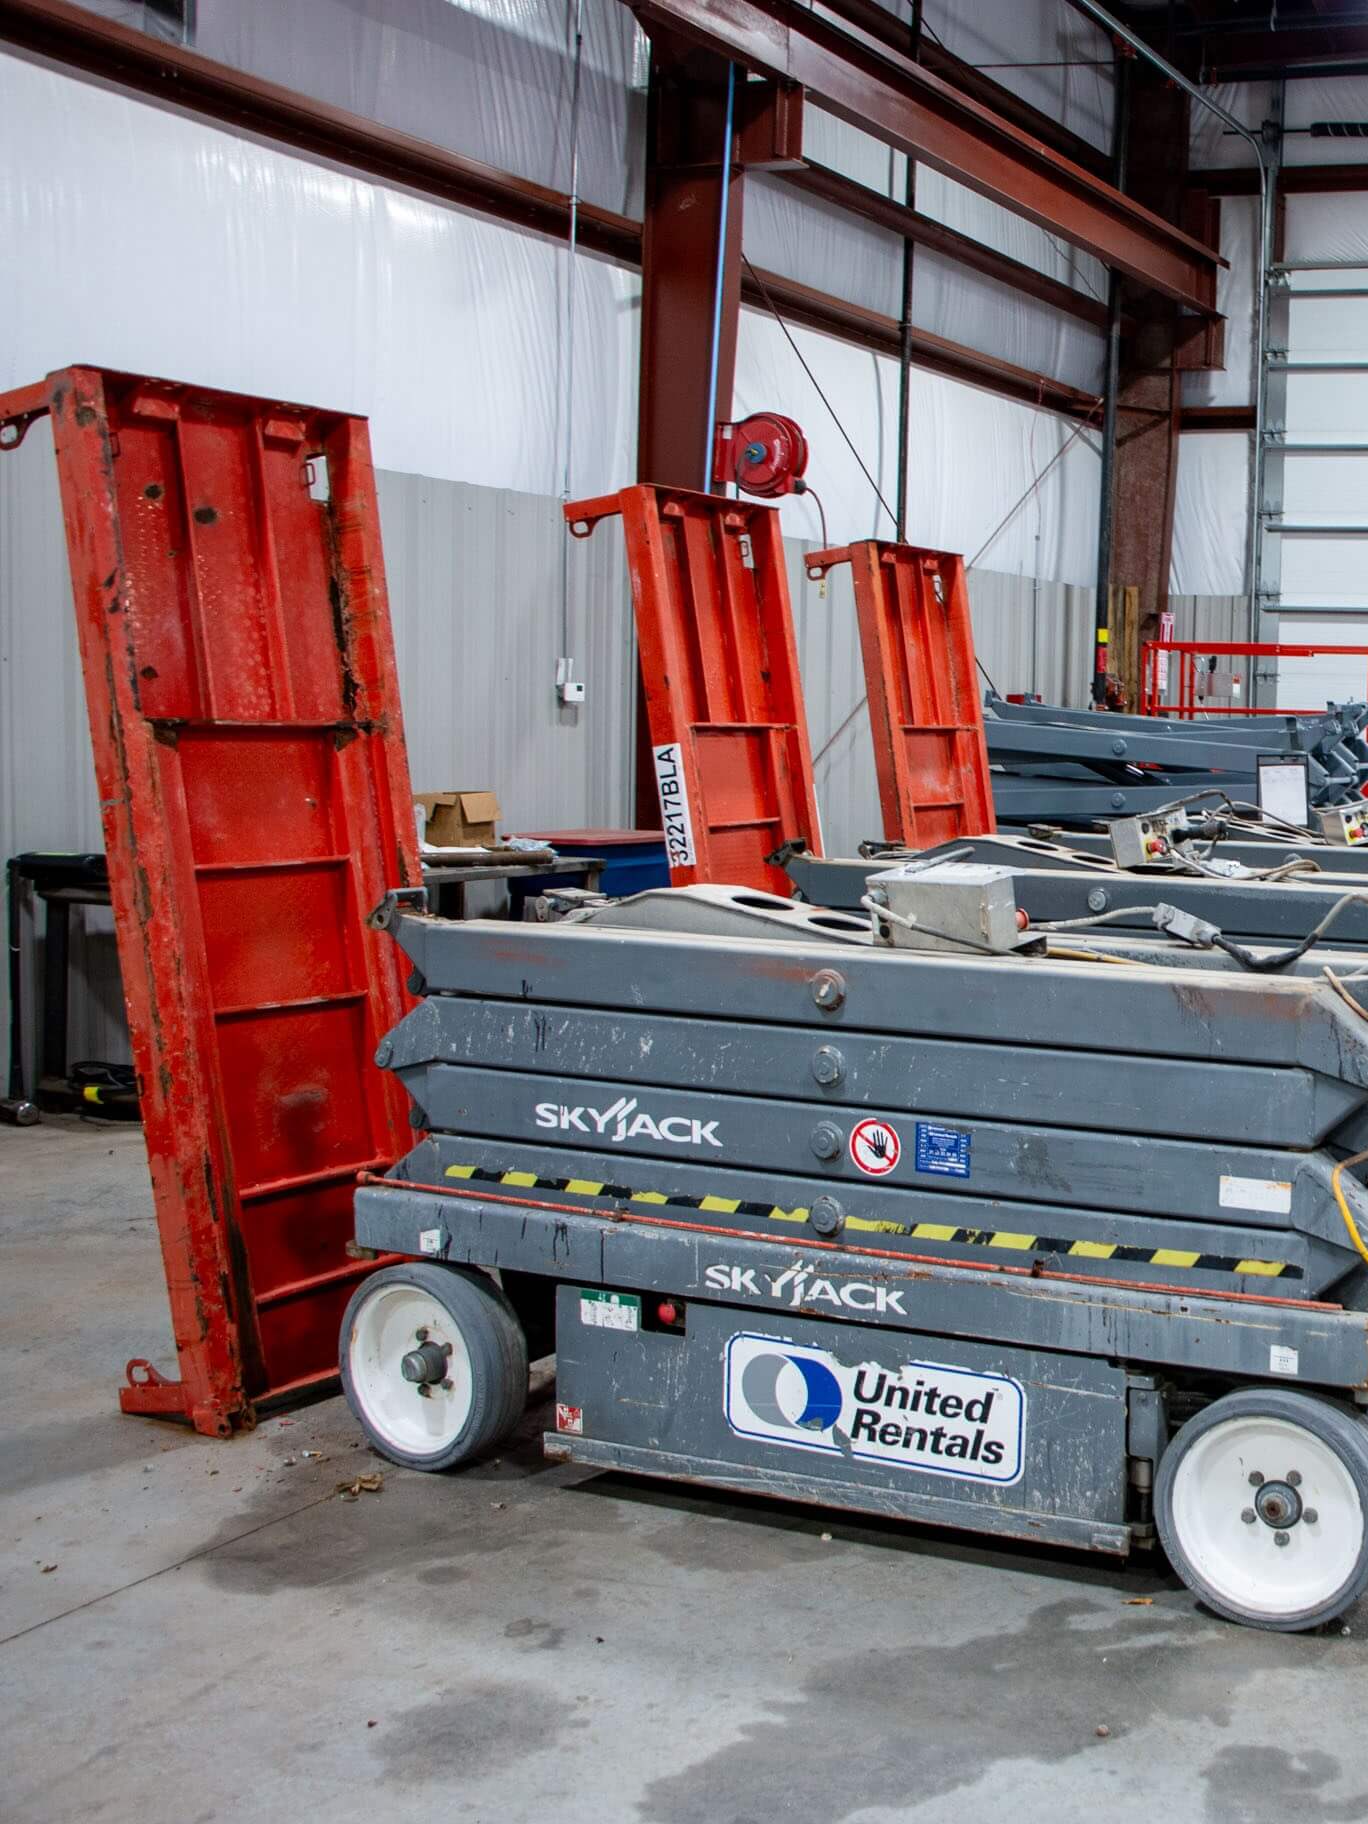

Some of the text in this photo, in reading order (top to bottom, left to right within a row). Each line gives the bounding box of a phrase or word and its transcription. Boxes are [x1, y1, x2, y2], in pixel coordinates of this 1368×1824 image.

[535, 1097, 723, 1147] SKYJACK
[705, 1260, 907, 1315] SKYJACK
[853, 1370, 995, 1424] United
[851, 1408, 1005, 1464] Rentals
